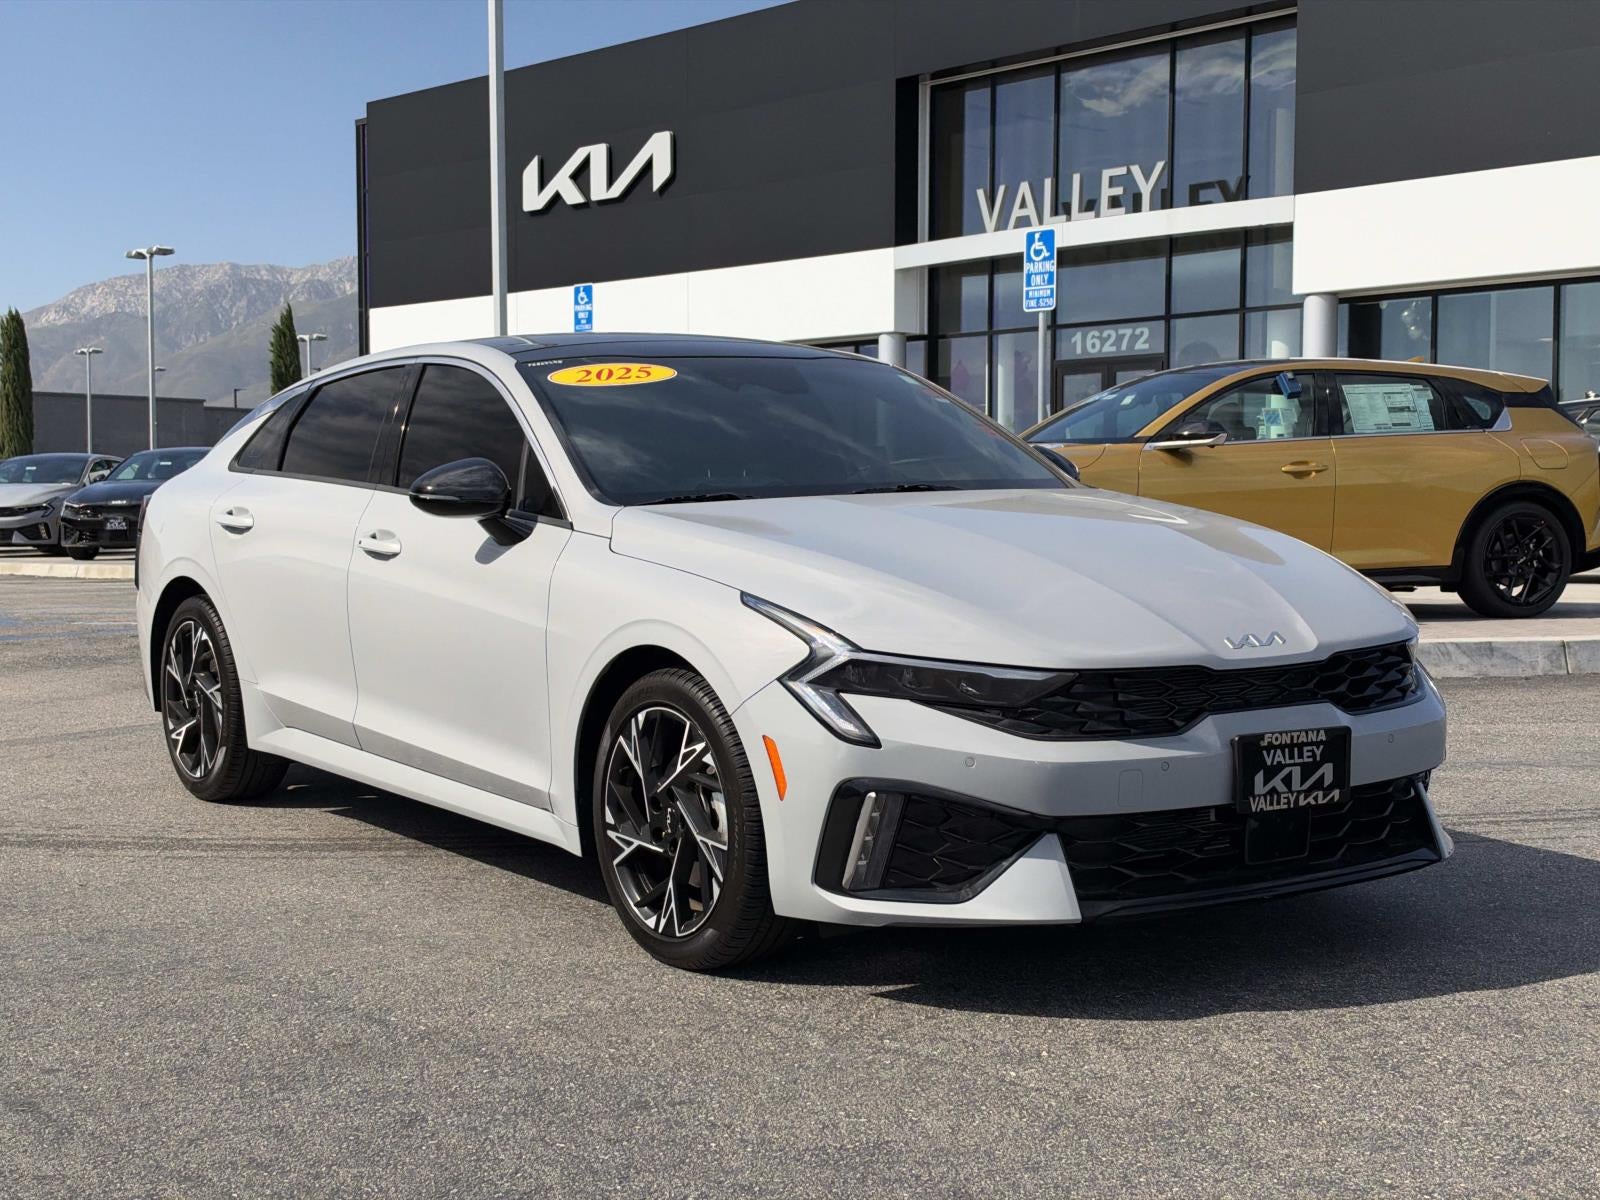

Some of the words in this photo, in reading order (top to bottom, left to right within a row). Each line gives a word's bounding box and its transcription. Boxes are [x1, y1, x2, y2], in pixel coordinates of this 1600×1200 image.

[523, 131, 673, 212] KIA
[976, 160, 1166, 233] VALLEY
[1025, 260, 1055, 274] PARKING
[1030, 273, 1049, 286] ONLY
[1029, 288, 1051, 298] MINIMUM
[1071, 327, 1149, 355] 16272
[575, 366, 652, 383] 2025
[1223, 631, 1287, 649] KIA
[1263, 730, 1326, 745] FONTANA
[1262, 745, 1324, 766] VALLEY
[1254, 762, 1333, 795] KIA
[1248, 792, 1297, 813] VALLEY
[1298, 789, 1340, 806] KIA
